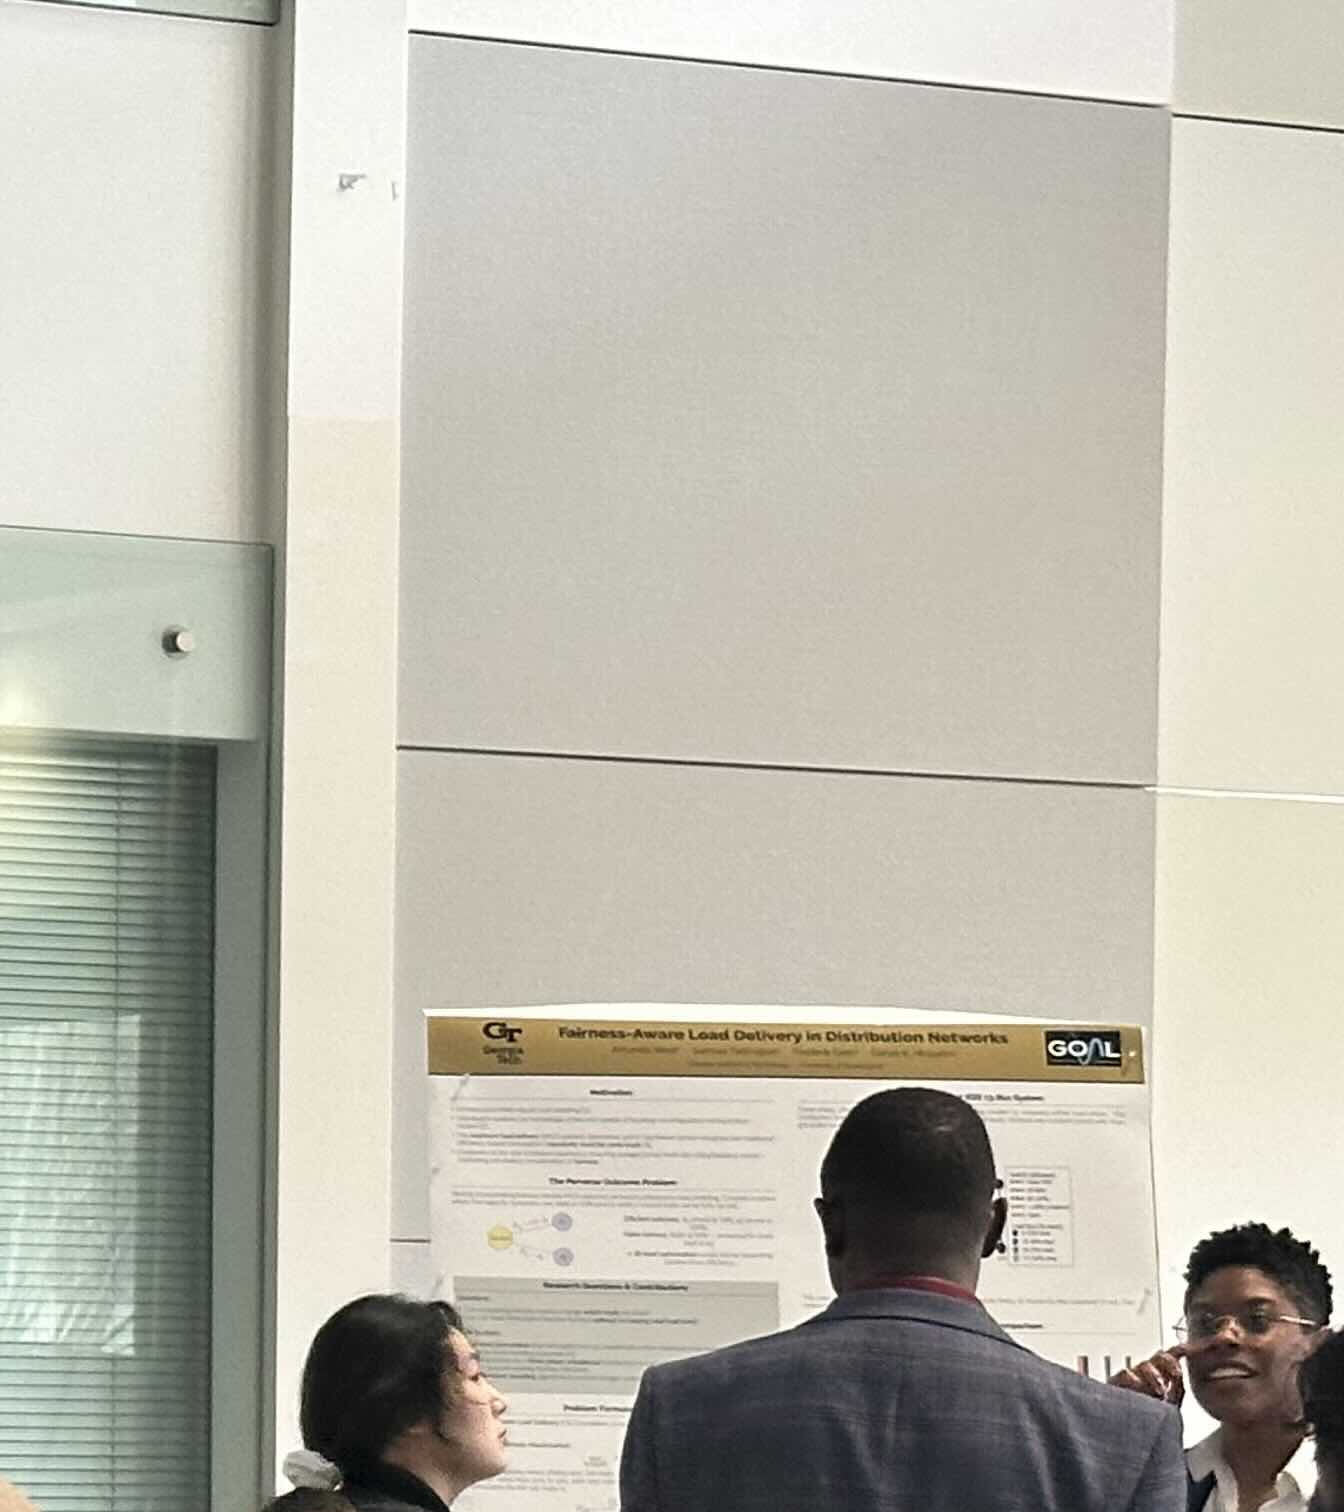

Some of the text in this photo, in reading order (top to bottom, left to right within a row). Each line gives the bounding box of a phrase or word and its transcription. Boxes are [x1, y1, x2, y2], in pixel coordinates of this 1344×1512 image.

[483, 1022, 523, 1042] GT
[559, 1026, 1009, 1045] Fairness-Aware Load Delivery in Distribution Networks
[1047, 1037, 1122, 1063] GOAL
